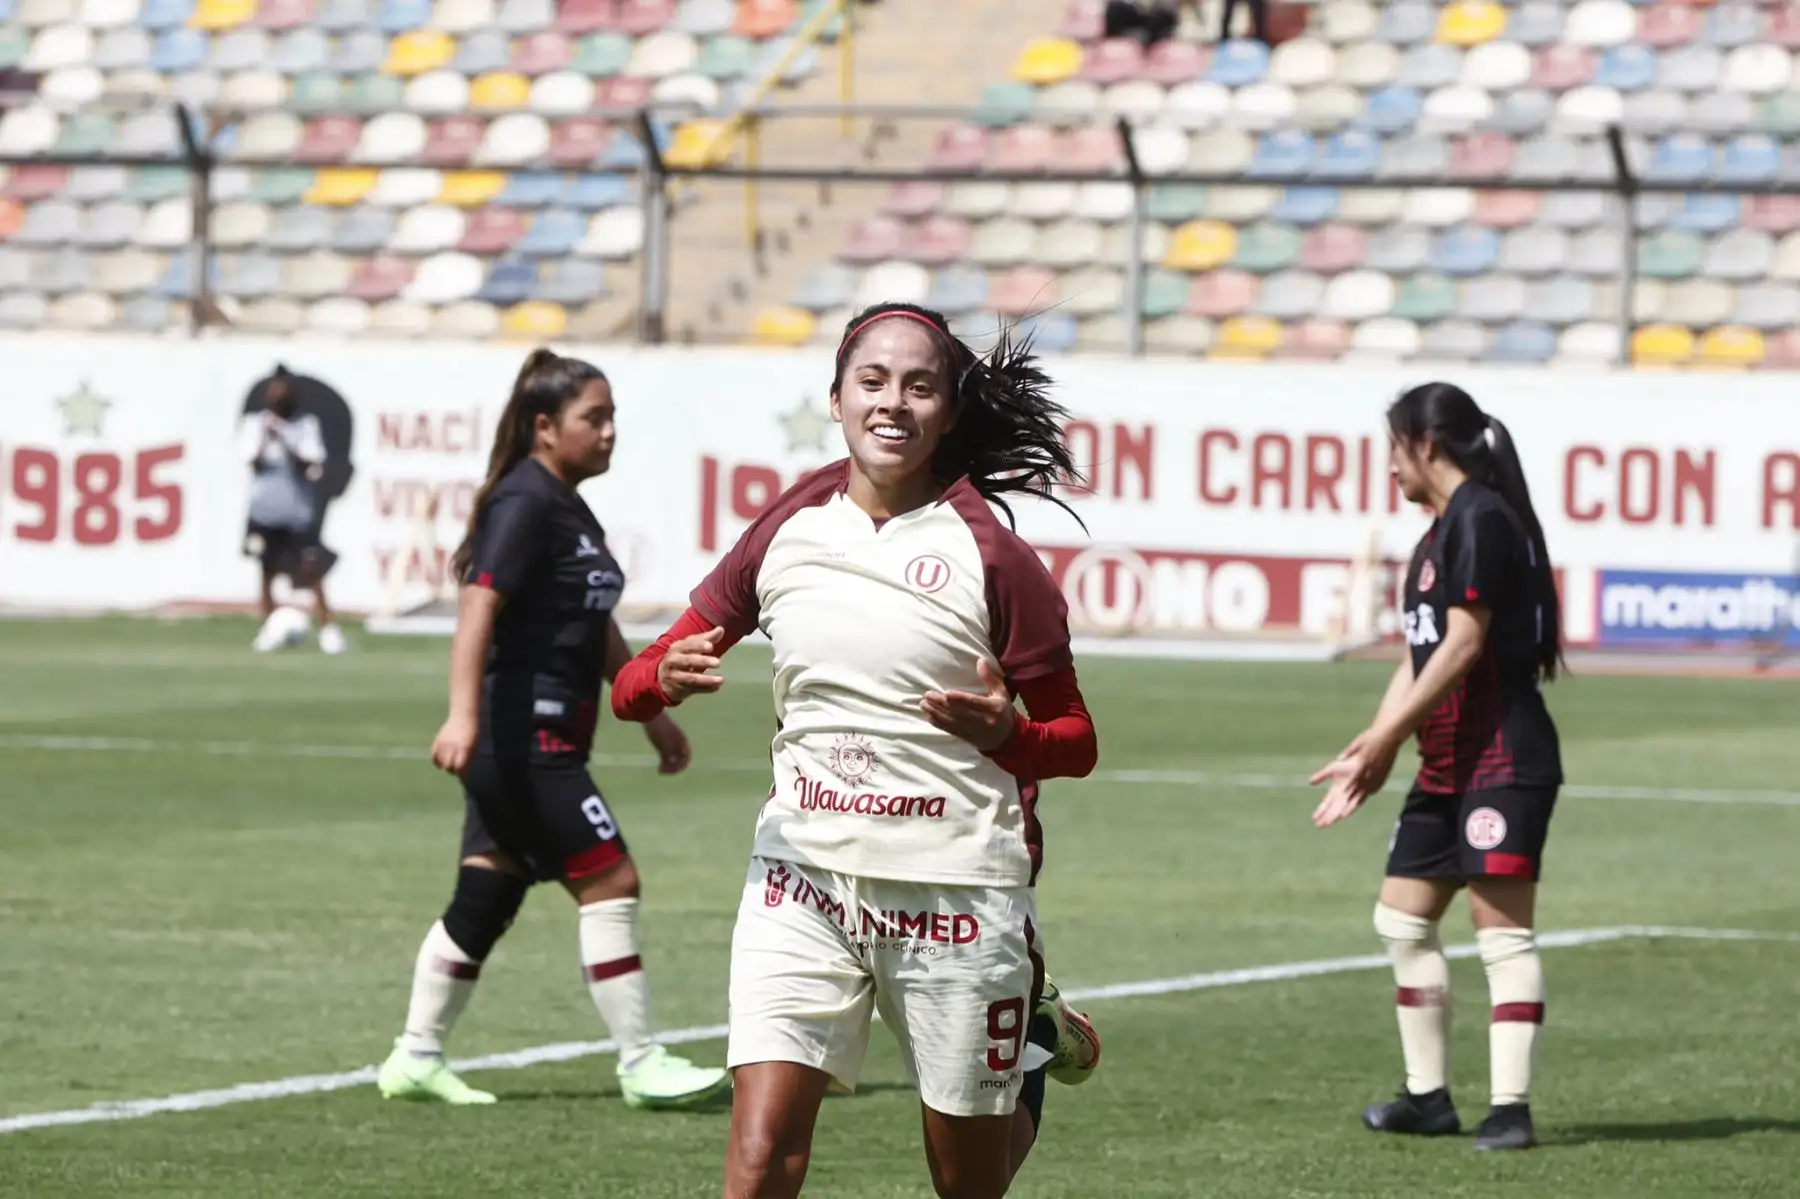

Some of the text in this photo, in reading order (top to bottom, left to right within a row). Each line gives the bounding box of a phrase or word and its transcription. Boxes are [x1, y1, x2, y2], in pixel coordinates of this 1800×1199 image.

[1564, 446, 1717, 527] CON
[915, 561, 941, 588] U
[581, 795, 617, 840] 9
[794, 766, 945, 818] Wawasana
[987, 997, 1024, 1071] 9
